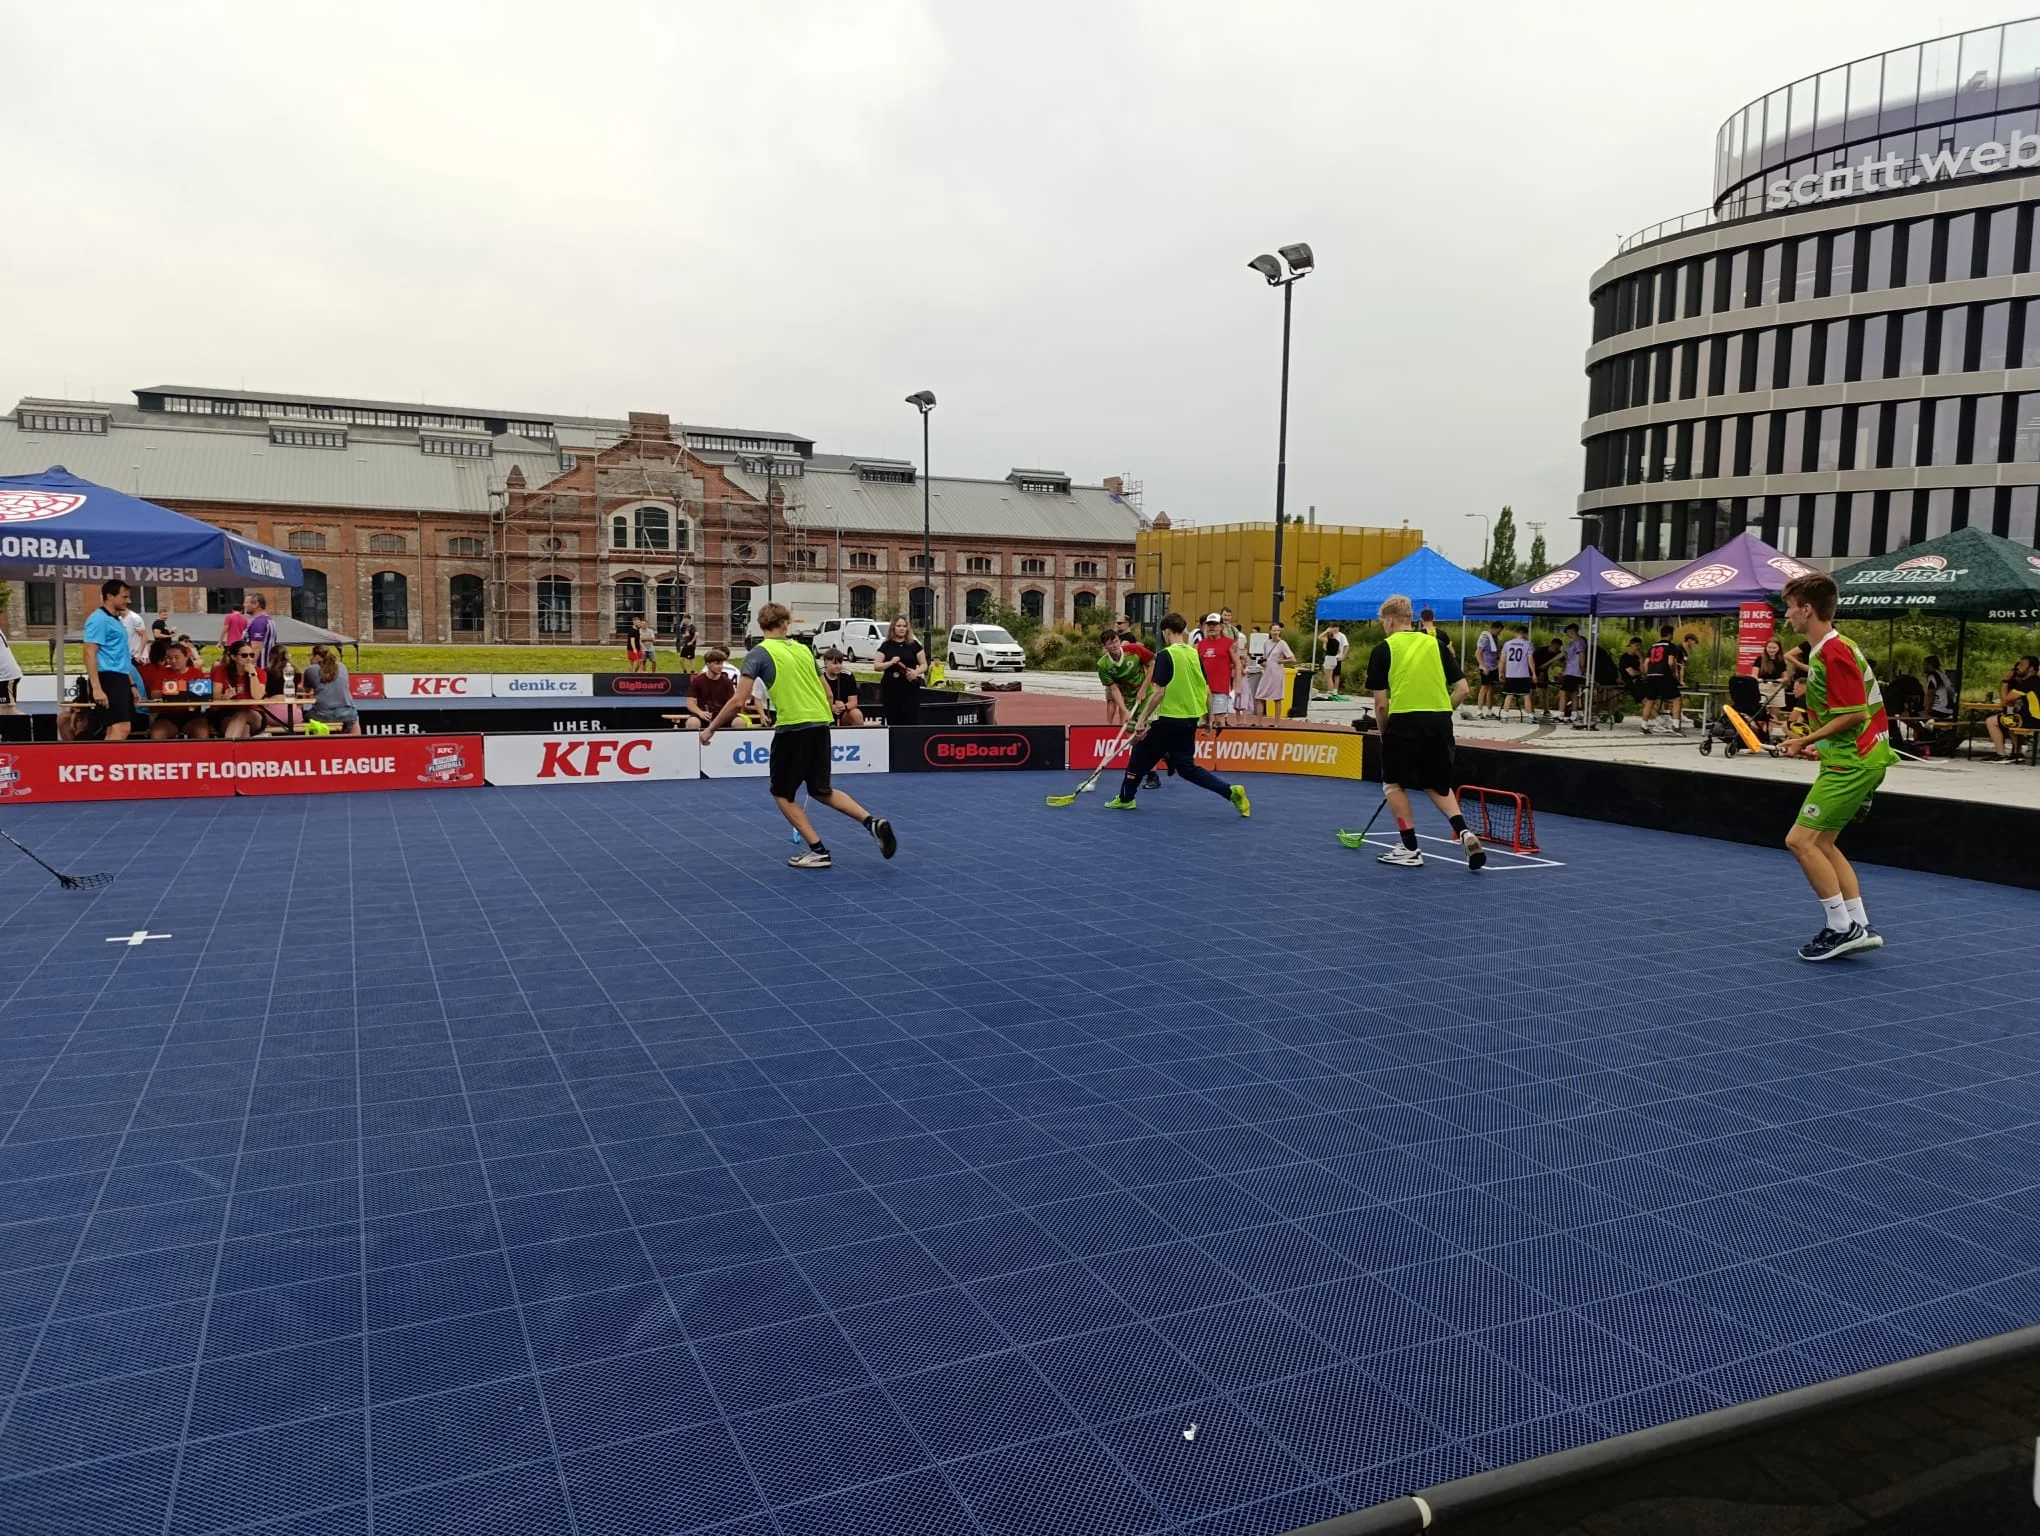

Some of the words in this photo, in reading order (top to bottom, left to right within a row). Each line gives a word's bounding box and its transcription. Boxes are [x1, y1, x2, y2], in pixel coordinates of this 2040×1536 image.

[0, 536, 91, 560] ORBAL
[1643, 599, 1671, 610] ČESKÝ
[1670, 600, 1709, 609] FLORBAL
[1859, 596, 1892, 605] PIVO
[1893, 596, 1904, 604] Z
[1905, 595, 1937, 604] HOR
[1752, 610, 1773, 619] KFC
[1508, 647, 1523, 662] 20
[410, 677, 468, 695] KFC
[618, 680, 665, 691] BigBoard
[537, 739, 653, 778] KFC
[936, 743, 1018, 760] BigBoard
[1216, 741, 1278, 761] WOMEN
[1281, 743, 1338, 765] POWER
[59, 764, 104, 783] KFC
[109, 762, 192, 782] STREET
[197, 759, 317, 780] FLOORBALL
[320, 757, 396, 775] LEAGUE
